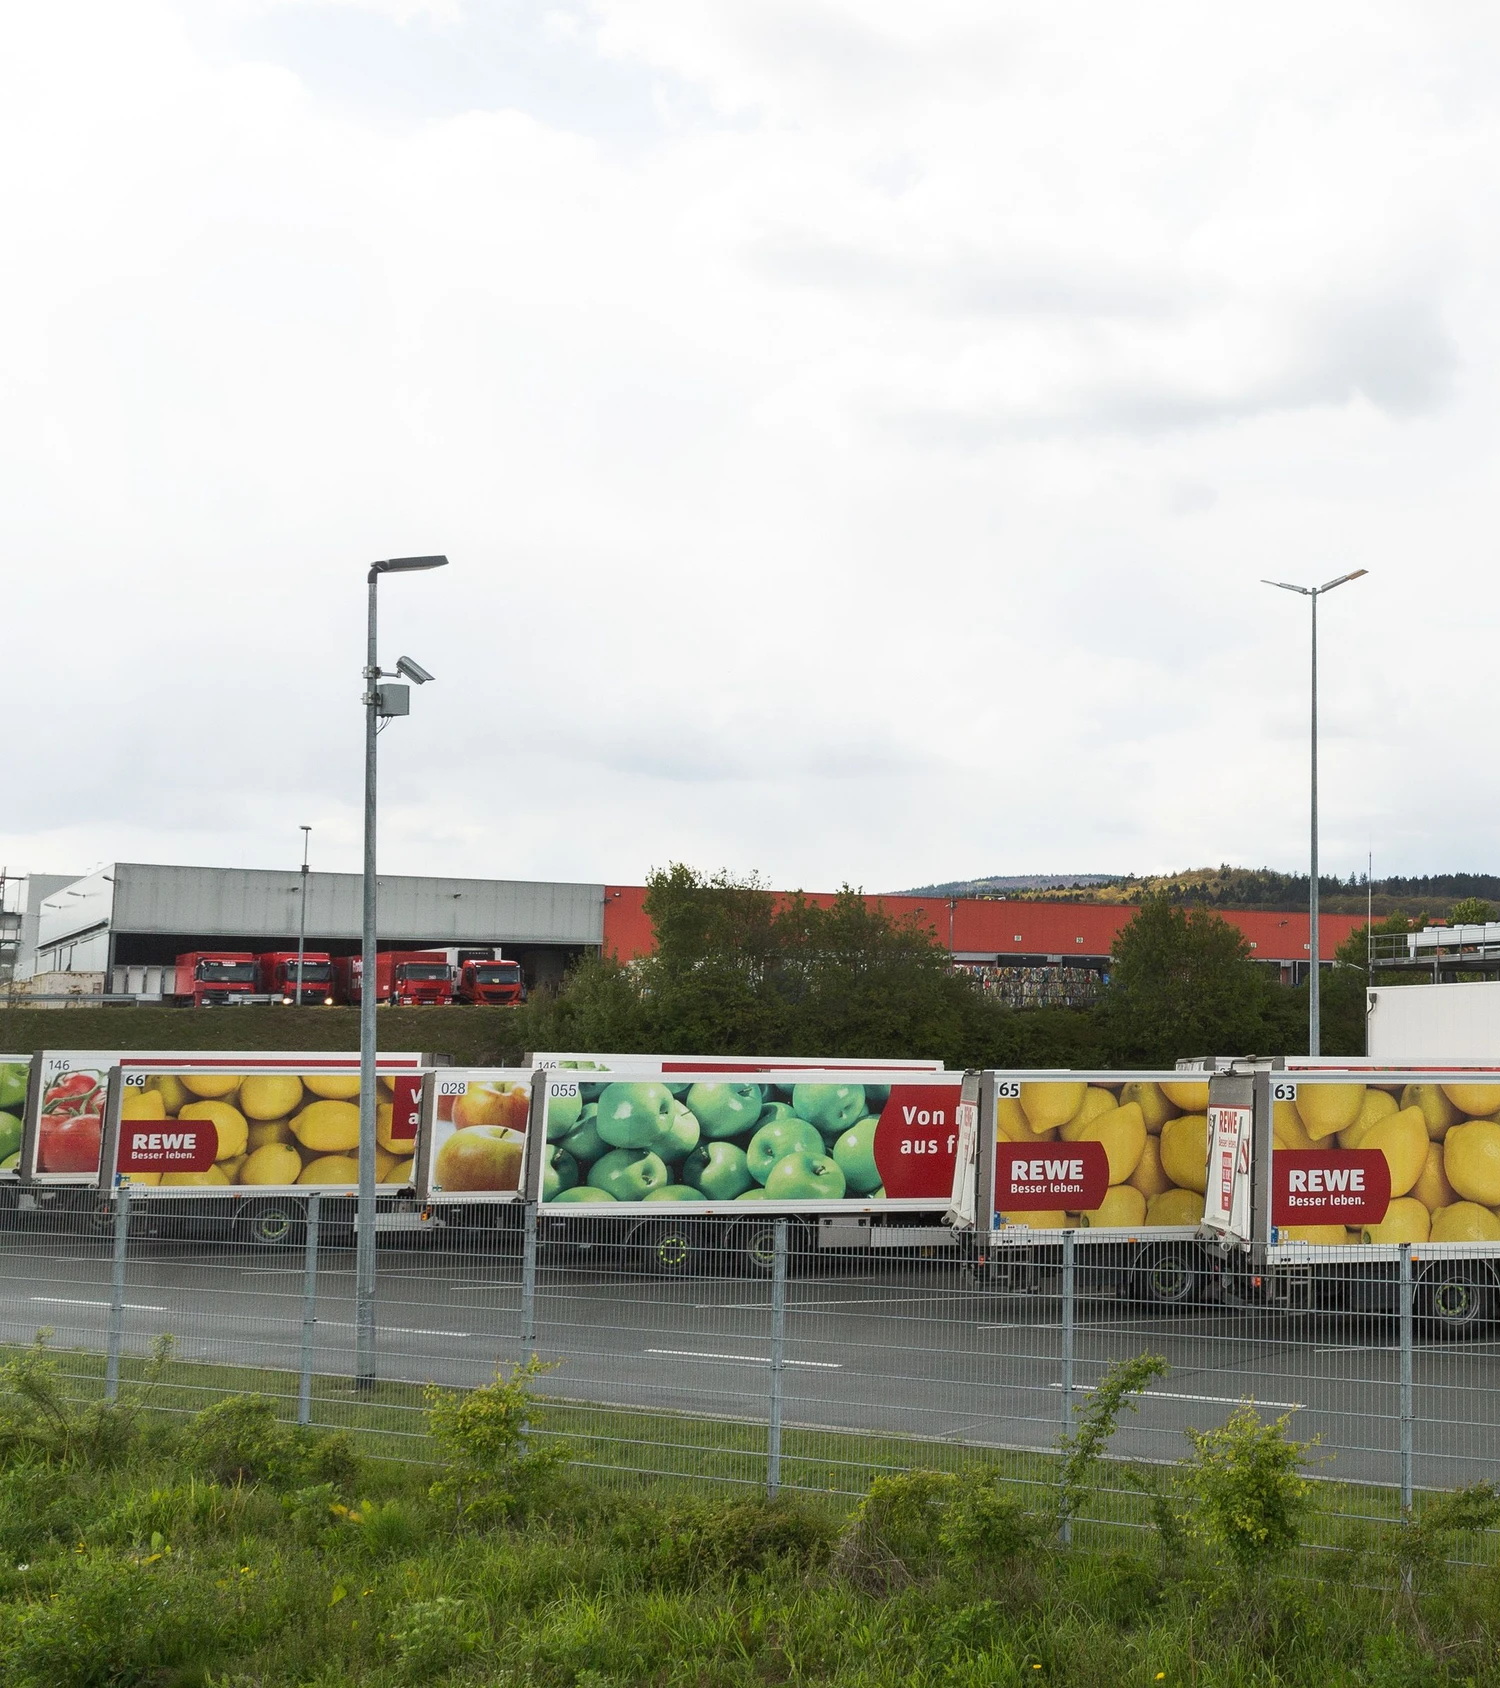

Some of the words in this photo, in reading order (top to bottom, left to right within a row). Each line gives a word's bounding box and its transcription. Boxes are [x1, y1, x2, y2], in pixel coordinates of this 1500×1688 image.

[48, 1060, 70, 1070] 146
[125, 1074, 145, 1086] 66
[441, 1082, 466, 1094] 028
[551, 1084, 577, 1097] 055
[999, 1082, 1019, 1097] 65
[1274, 1084, 1296, 1100] 63
[902, 1106, 945, 1126] Von
[1219, 1111, 1237, 1134] REWE
[131, 1134, 197, 1150] REWE
[900, 1139, 938, 1154] aus
[131, 1152, 164, 1160] Besser
[165, 1151, 196, 1160] leben.
[1011, 1160, 1084, 1180] REWE
[1011, 1183, 1047, 1194] Besser
[1050, 1182, 1084, 1193] leben.
[1289, 1169, 1366, 1192] REWE
[1288, 1195, 1327, 1207] Besser
[1330, 1194, 1366, 1206] leben.
